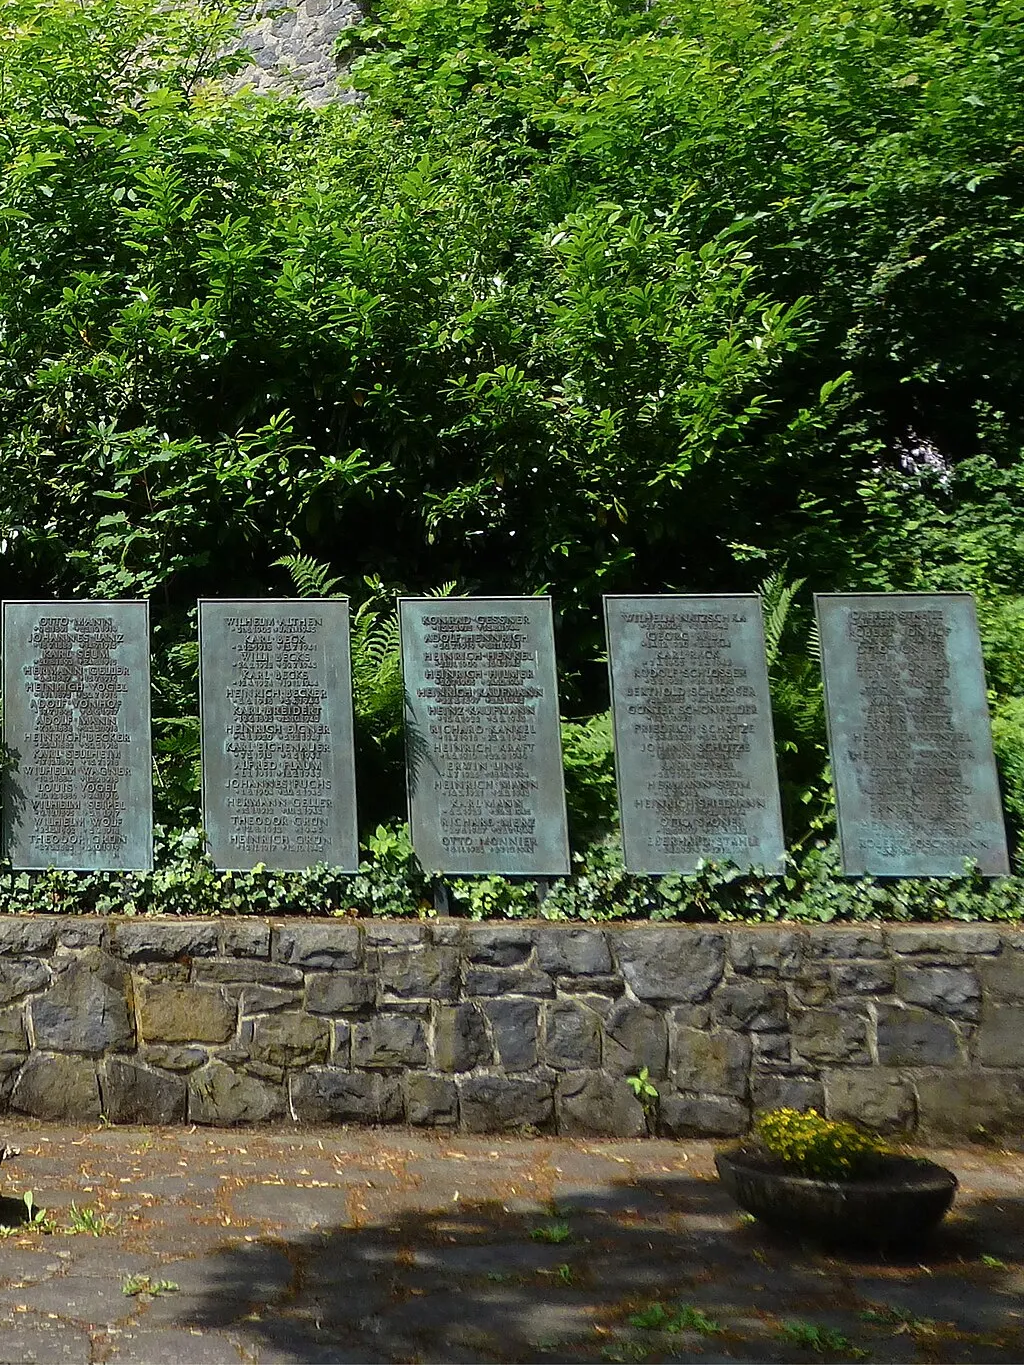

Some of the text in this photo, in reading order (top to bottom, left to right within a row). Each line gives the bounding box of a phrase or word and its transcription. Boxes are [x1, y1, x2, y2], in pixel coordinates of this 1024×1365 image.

[39, 617, 113, 626] OTTO MANN
[226, 617, 275, 627] WILHELM
[28, 634, 89, 643] JOHANNES
[245, 635, 272, 644] KARL
[424, 634, 462, 643] ADOLF
[42, 650, 72, 658] KARL
[424, 652, 482, 662] HEINRICH
[24, 666, 85, 676] HERMANN
[242, 670, 270, 679] KARL
[425, 670, 482, 679] HEINRICH
[25, 683, 128, 692] HEINRICH VOGEL
[225, 689, 279, 699] HEINRICH
[233, 706, 261, 716] KARL
[36, 716, 117, 725] ADOLF MANN
[225, 724, 282, 734] HEINRICH
[24, 733, 80, 742] HEINRICH
[225, 743, 253, 752] KARL
[234, 761, 276, 770] ALFRED
[24, 766, 76, 776] WILHELM
[79, 783, 117, 792] VOGEL
[225, 779, 287, 789] JOHANNES
[227, 798, 287, 807] HERMANN
[231, 816, 288, 826] THEODOR
